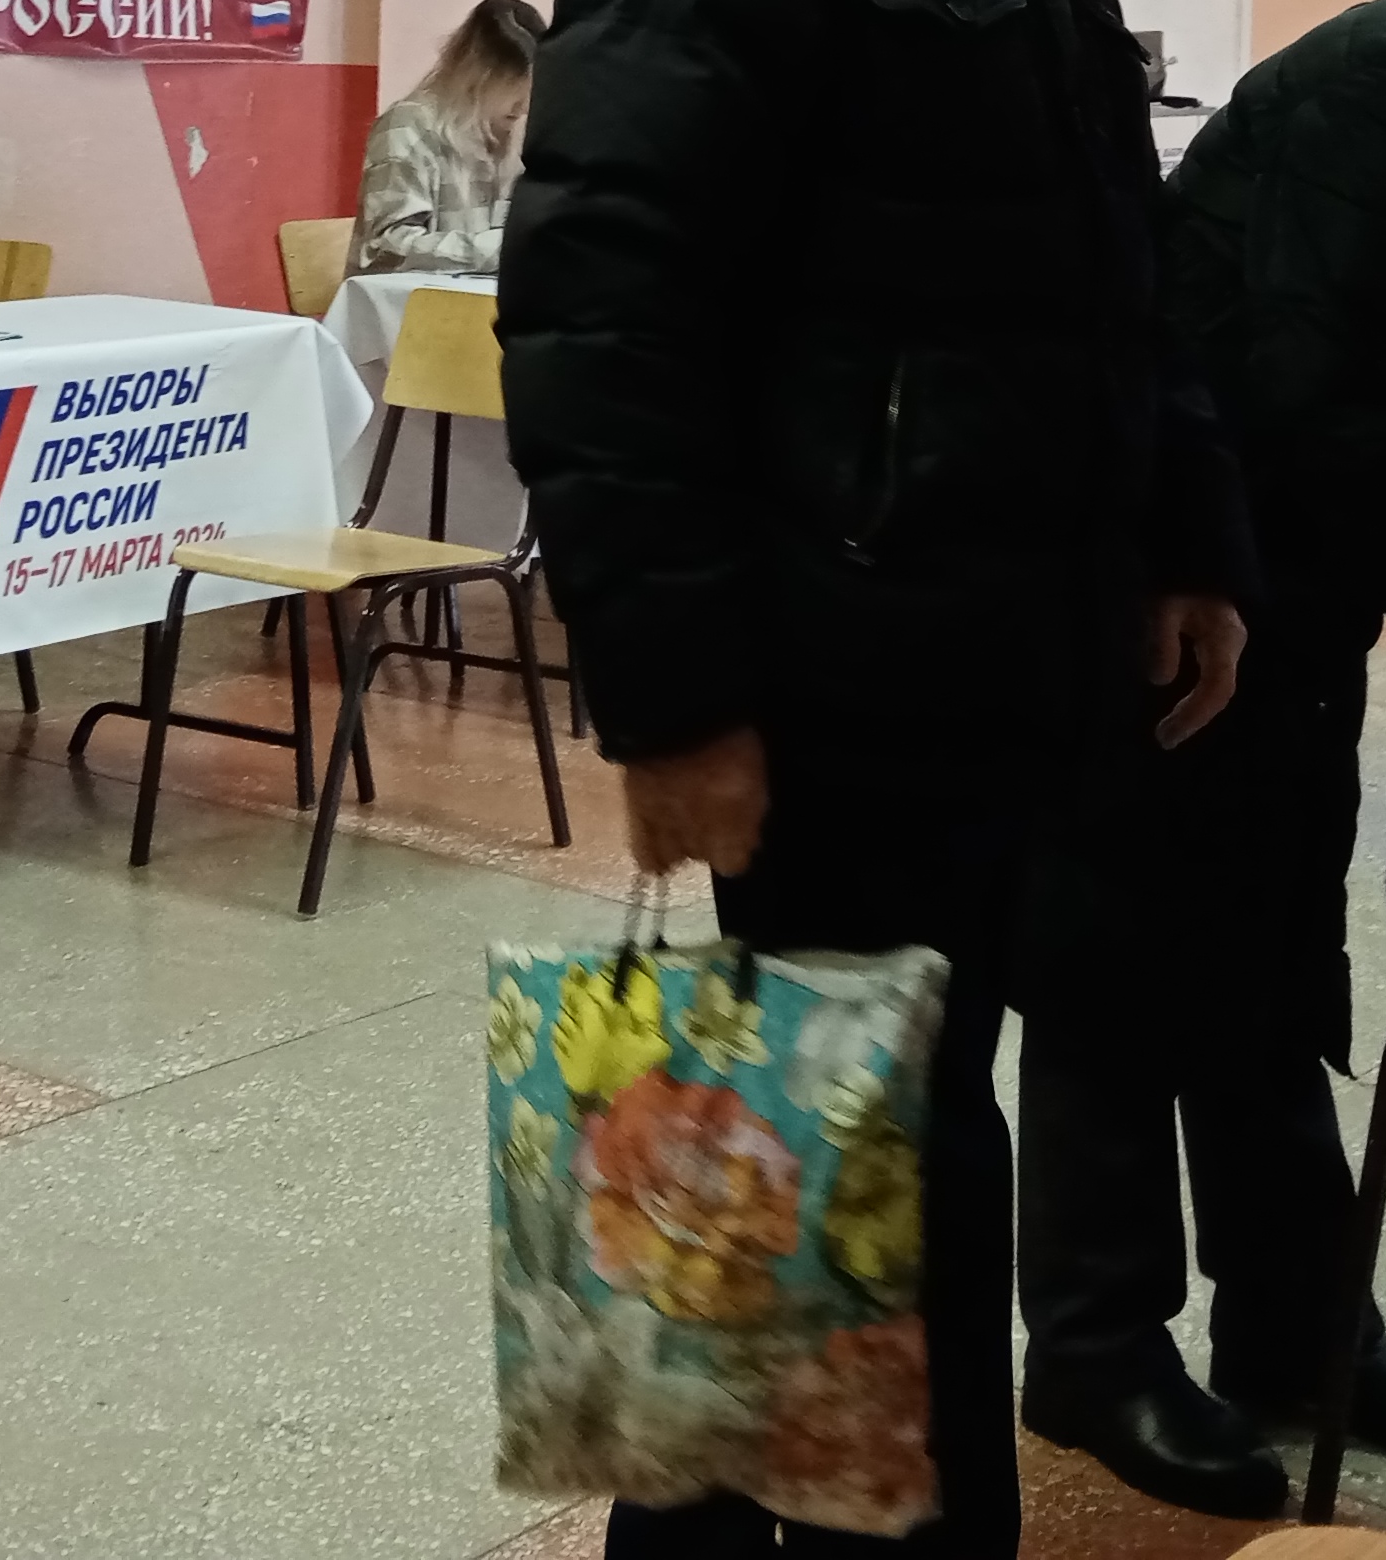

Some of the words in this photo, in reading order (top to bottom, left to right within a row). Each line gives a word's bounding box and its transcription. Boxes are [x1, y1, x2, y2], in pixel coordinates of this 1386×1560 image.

[50, 364, 210, 423] ВЫБОРЫ
[30, 411, 249, 483] ПРЕЗИДЕНТА
[13, 480, 161, 544] РОССИИ
[77, 533, 163, 583] МАРТА
